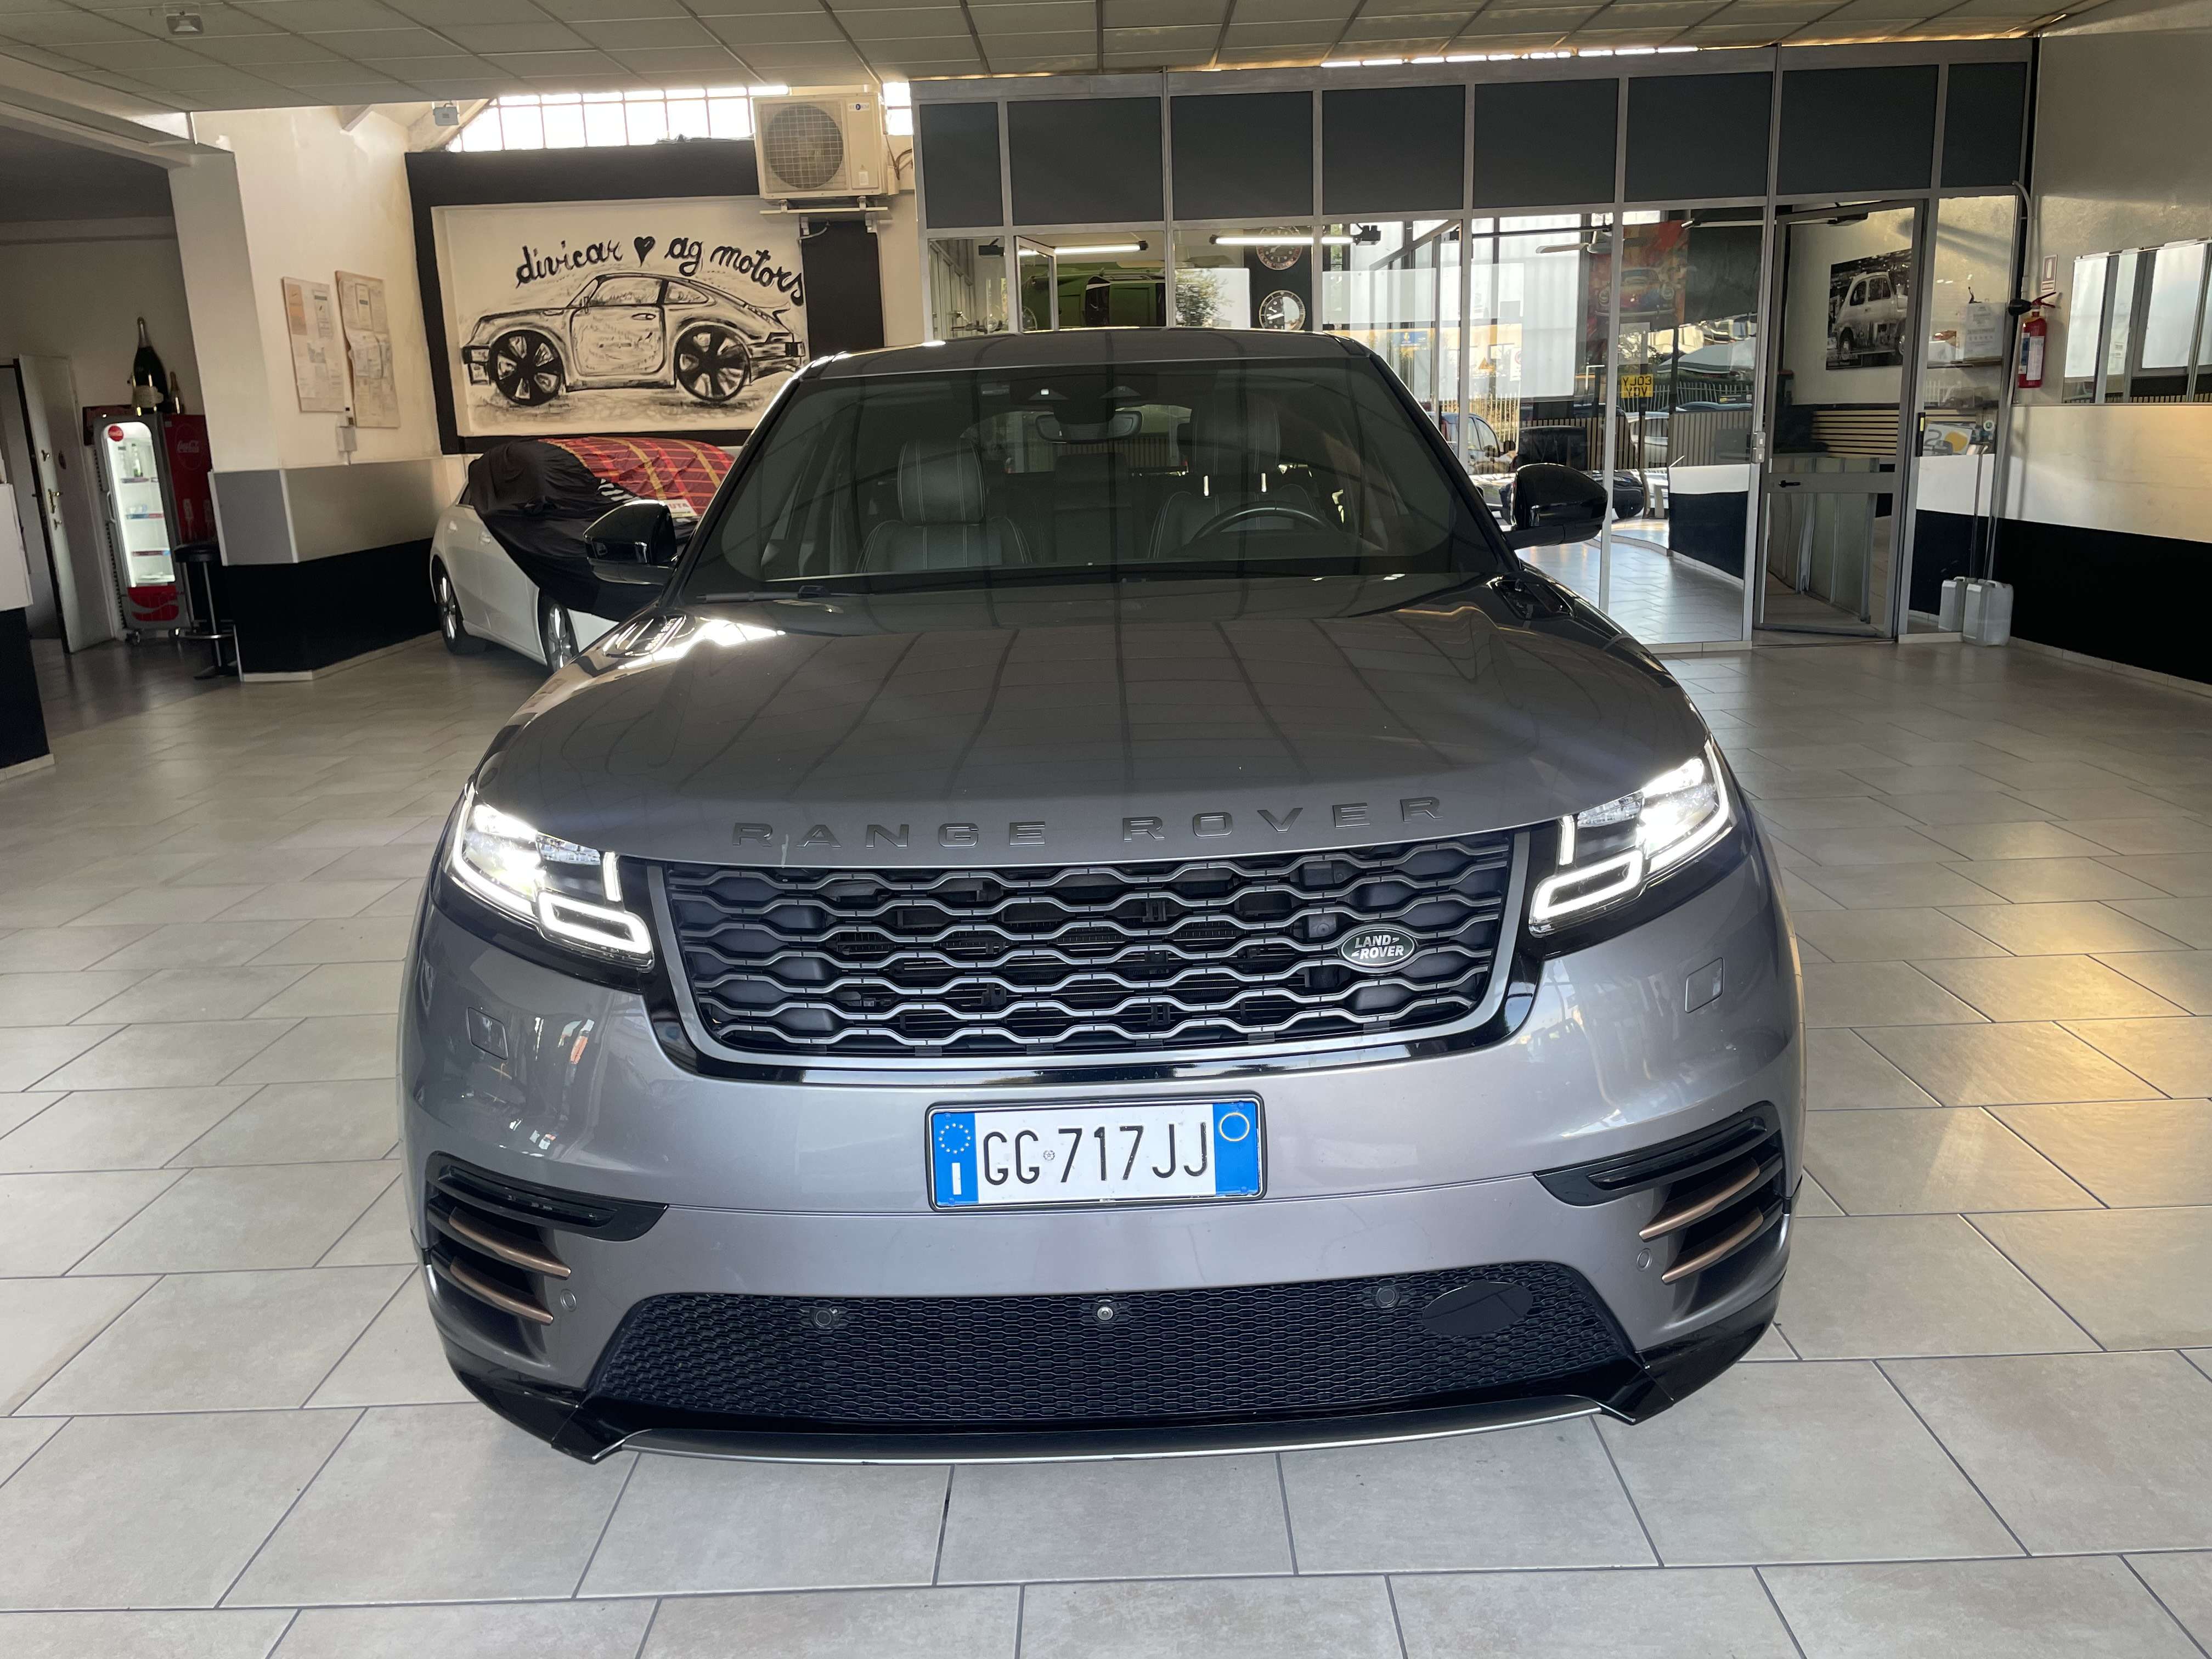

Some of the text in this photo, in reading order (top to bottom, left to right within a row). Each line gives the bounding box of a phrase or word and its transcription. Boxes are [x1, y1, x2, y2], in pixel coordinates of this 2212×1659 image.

[516, 236, 804, 306] divicar ag motors
[732, 796, 1444, 848] RANGE ROVER
[1354, 934, 1391, 949] LAND
[1359, 945, 1404, 960] ROVER
